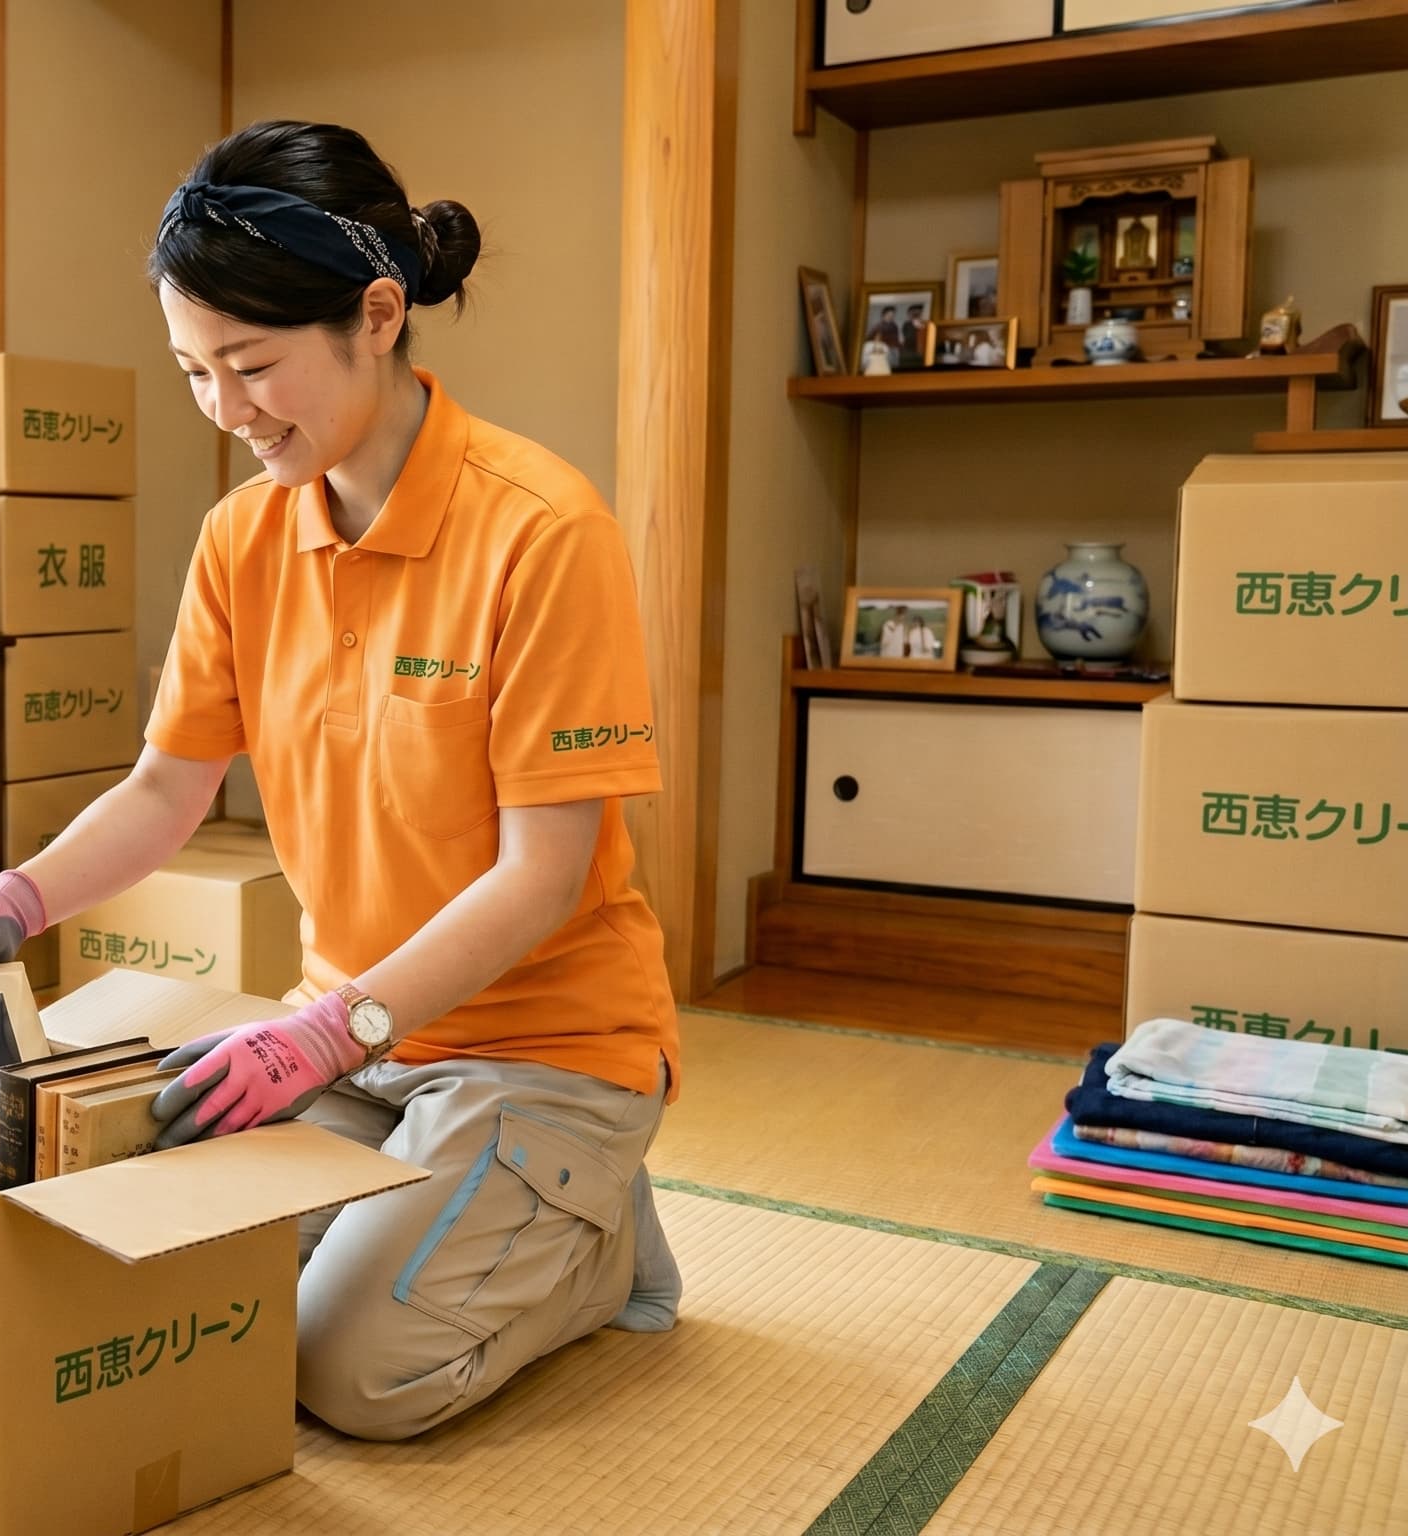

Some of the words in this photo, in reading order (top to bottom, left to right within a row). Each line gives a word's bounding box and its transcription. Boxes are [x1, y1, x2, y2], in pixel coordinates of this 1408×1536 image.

[23, 409, 123, 444] 西恵クリーン
[38, 544, 107, 588] 衣服
[394, 655, 481, 680] 西恵クリーン
[25, 688, 123, 723] 西恵クリーン
[551, 723, 653, 751] 西恵クリーン
[1201, 791, 1408, 845] 西恵クリ
[79, 928, 216, 975] 西恵クリーン
[56, 1299, 260, 1404] 西恵クリーン
